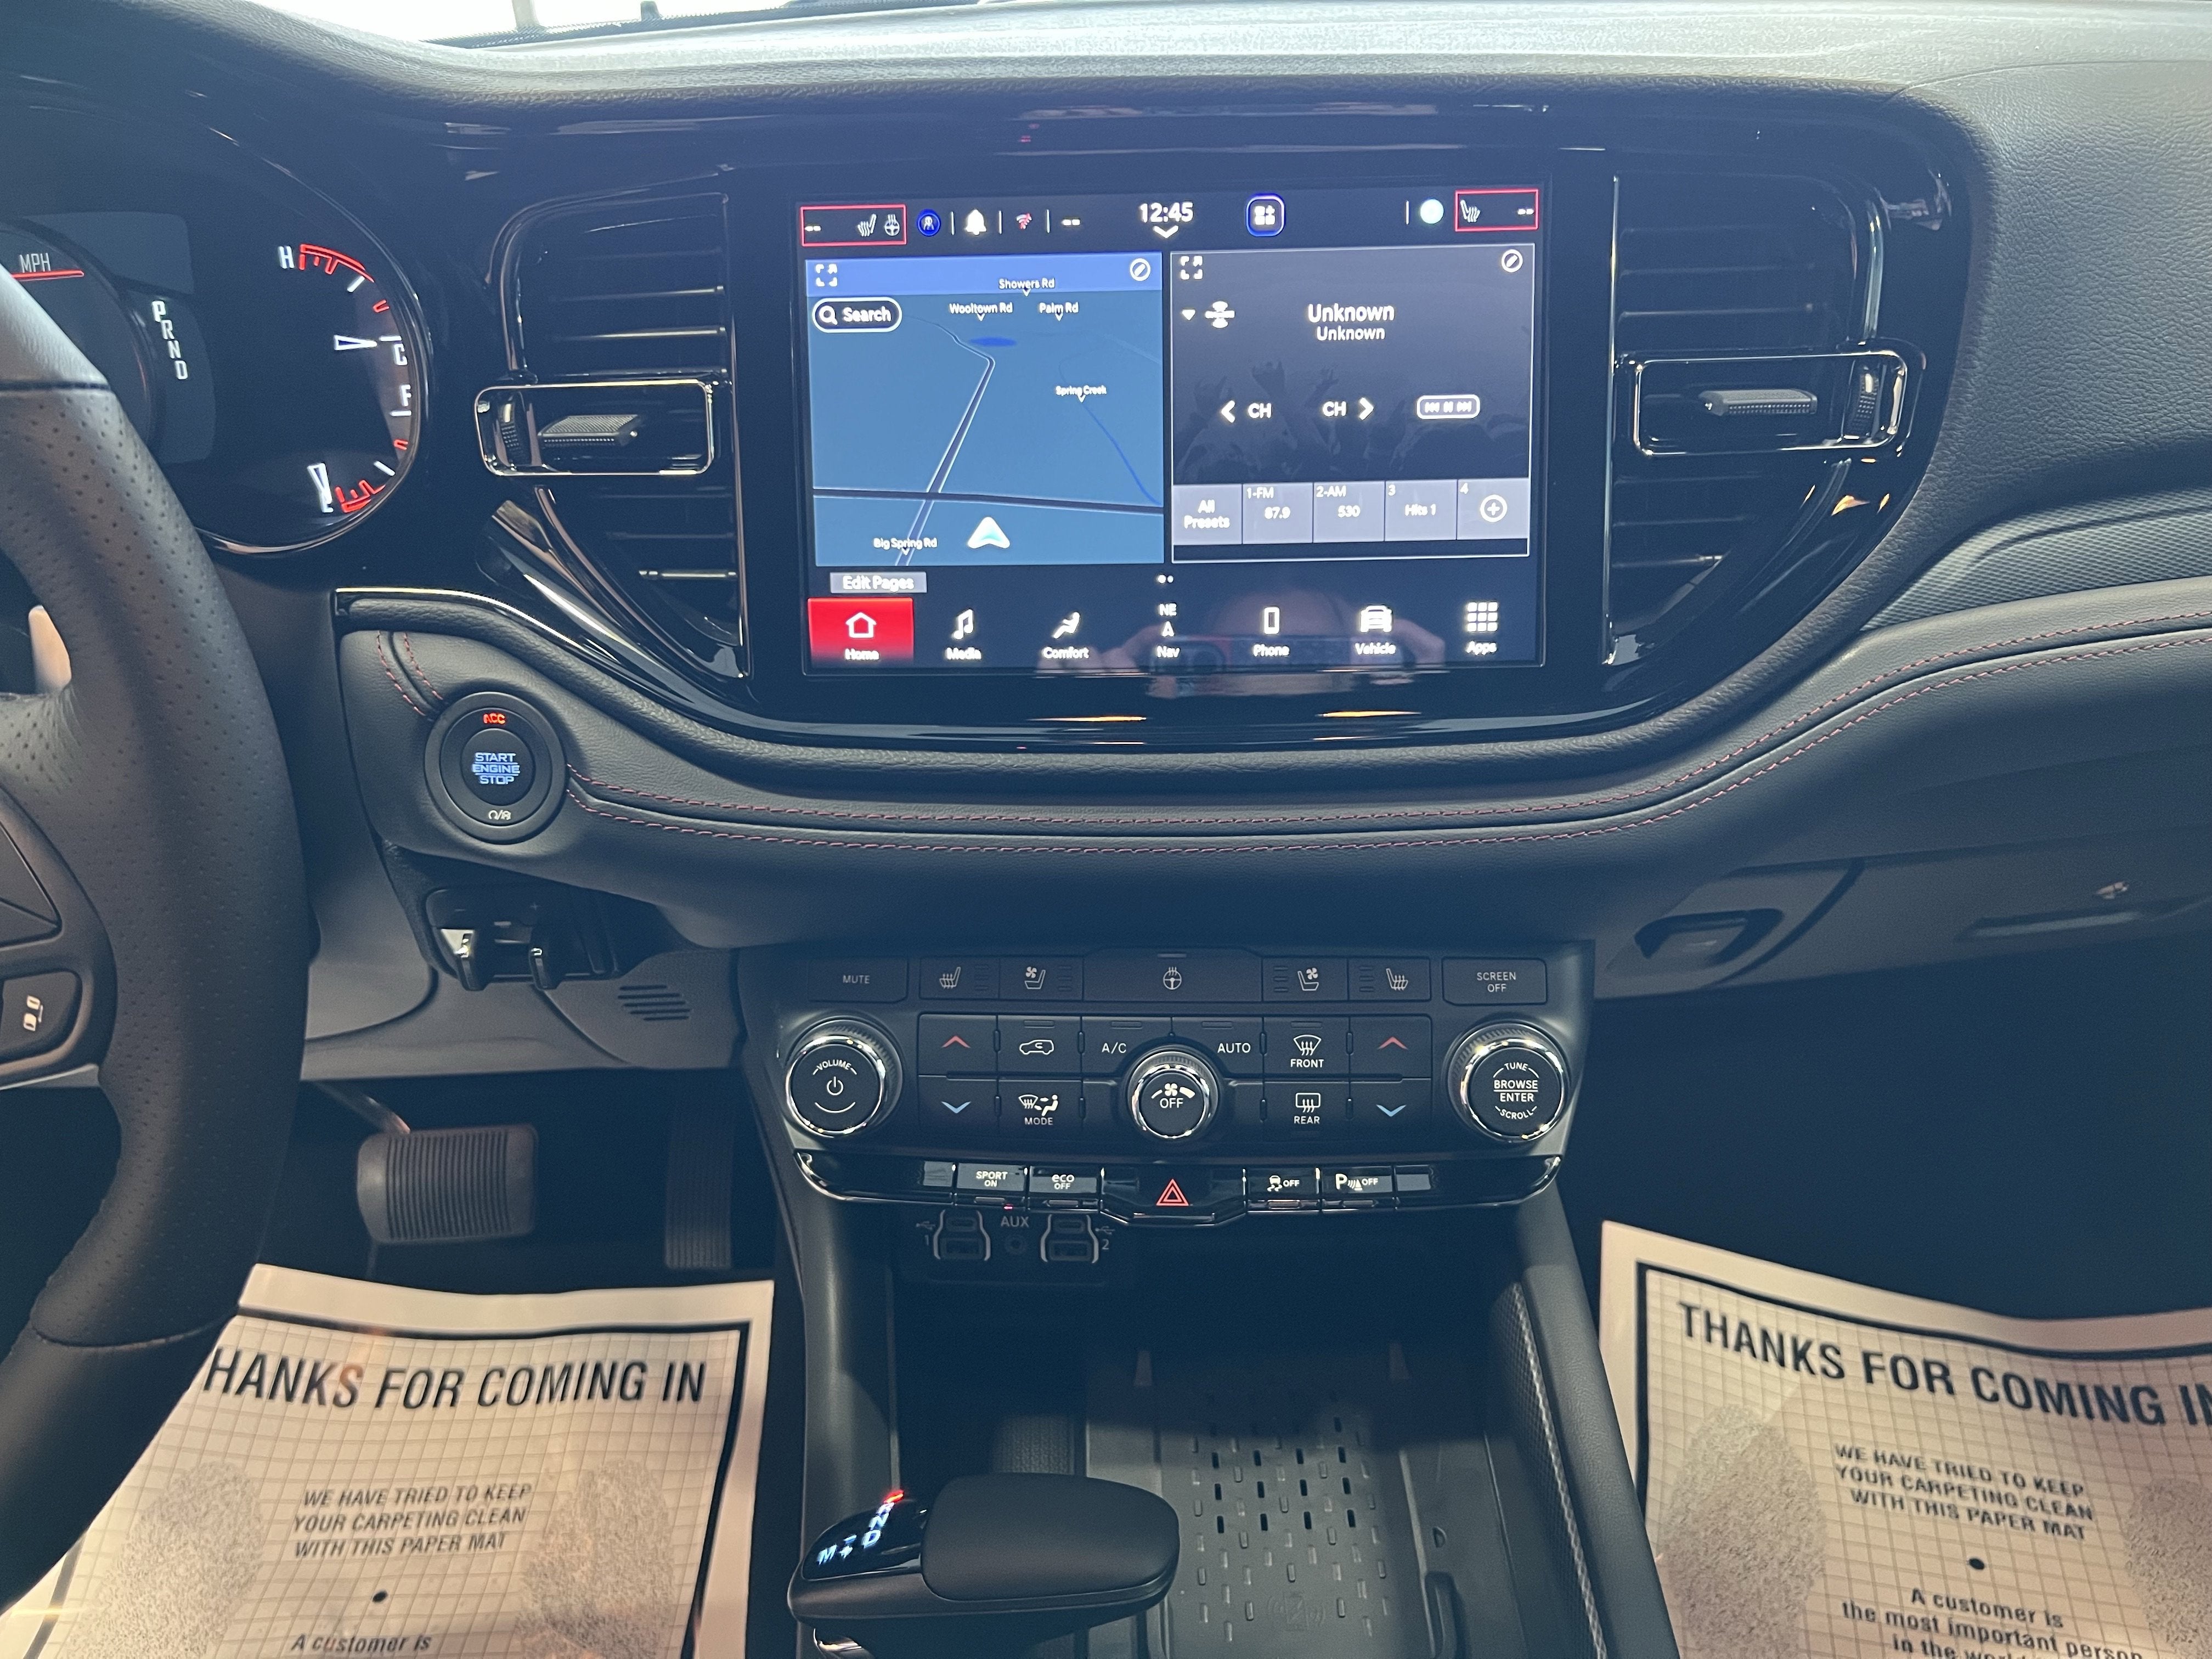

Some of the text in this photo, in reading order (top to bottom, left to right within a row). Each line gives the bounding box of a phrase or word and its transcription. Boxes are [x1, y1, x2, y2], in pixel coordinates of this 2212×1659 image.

[1140, 202, 1193, 223] 12:45
[20, 253, 50, 273] MPH
[279, 246, 295, 268] H
[998, 278, 1055, 290] Showers Rd
[949, 302, 1013, 313] Wooltown Rd
[1039, 302, 1079, 313] Palm Rd
[1308, 303, 1395, 323] Unknown
[843, 306, 891, 322] Search
[1317, 326, 1385, 341] Unknown
[1056, 385, 1107, 396] Spring Creek
[1248, 402, 1271, 417] CH
[1323, 401, 1346, 416] CH
[1246, 487, 1273, 499] 1-FM
[1317, 486, 1346, 498] 2-AM
[1388, 484, 1396, 496] 3
[1460, 483, 1468, 494] 4
[1198, 500, 1215, 513] All
[1265, 506, 1290, 519] 87.9
[1338, 505, 1360, 517] 530
[1405, 503, 1436, 516] Hits 1
[1184, 515, 1229, 528] Presets
[874, 537, 937, 549] Big Spring Rd
[843, 575, 913, 592] Edit Pages
[1159, 603, 1177, 616] NE
[845, 648, 879, 660] Home
[947, 647, 981, 659] Media
[1043, 646, 1089, 659] Comfort
[1156, 645, 1180, 658] Nav
[1254, 644, 1289, 656] Phone
[1355, 642, 1396, 655] Vehicle
[1466, 641, 1497, 655] Apps
[483, 713, 506, 724] ACC
[475, 752, 516, 762] START
[472, 764, 520, 774] ENGINE
[479, 776, 515, 785] STOP
[843, 974, 871, 985] MUTE
[1477, 972, 1516, 981] SCREEN
[1487, 984, 1506, 993] OFF
[1102, 1043, 1127, 1054] A/C
[1217, 1043, 1251, 1054] AUTO
[819, 1060, 851, 1071] VOLUME
[1290, 1059, 1324, 1068] FRONT
[1504, 1062, 1528, 1071] TUNE
[1494, 1080, 1538, 1090] BROWSE
[1159, 1098, 1183, 1108] OFF
[1500, 1093, 1534, 1102] ENTER
[1294, 1116, 1320, 1125] REAR
[1499, 1109, 1533, 1120] SCROLL
[1024, 1117, 1053, 1126] MODE
[976, 1171, 1008, 1180] SPORT
[1052, 1175, 1075, 1183] eco
[1362, 1178, 1378, 1186] OFF
[1001, 1216, 1029, 1227] AUX
[1679, 1301, 1846, 1380] THANKS
[1863, 1351, 1955, 1396] FOR
[1973, 1365, 2166, 1426] COMING
[203, 1347, 707, 1408] HANKS FOR COMING IN
[1835, 1443, 2084, 1498] WE HAVE TRIED TO KEEP
[304, 1483, 532, 1506] WE HAVE TRIED TO KEEP
[1836, 1464, 2093, 1520] YOUR CARPETING CLEAN
[295, 1508, 527, 1532] YOUR CARPETING CLEAN
[1851, 1488, 2086, 1541] WITH THIS PAPER MAT
[295, 1533, 506, 1558] WITH THIS PAPER MAT
[1911, 1588, 2063, 1629] A customer is
[1843, 1600, 2142, 1659] the most important person
[292, 1634, 431, 1654] A customer is
[1893, 1634, 1914, 1654] in
[1921, 1639, 1955, 1659] the
